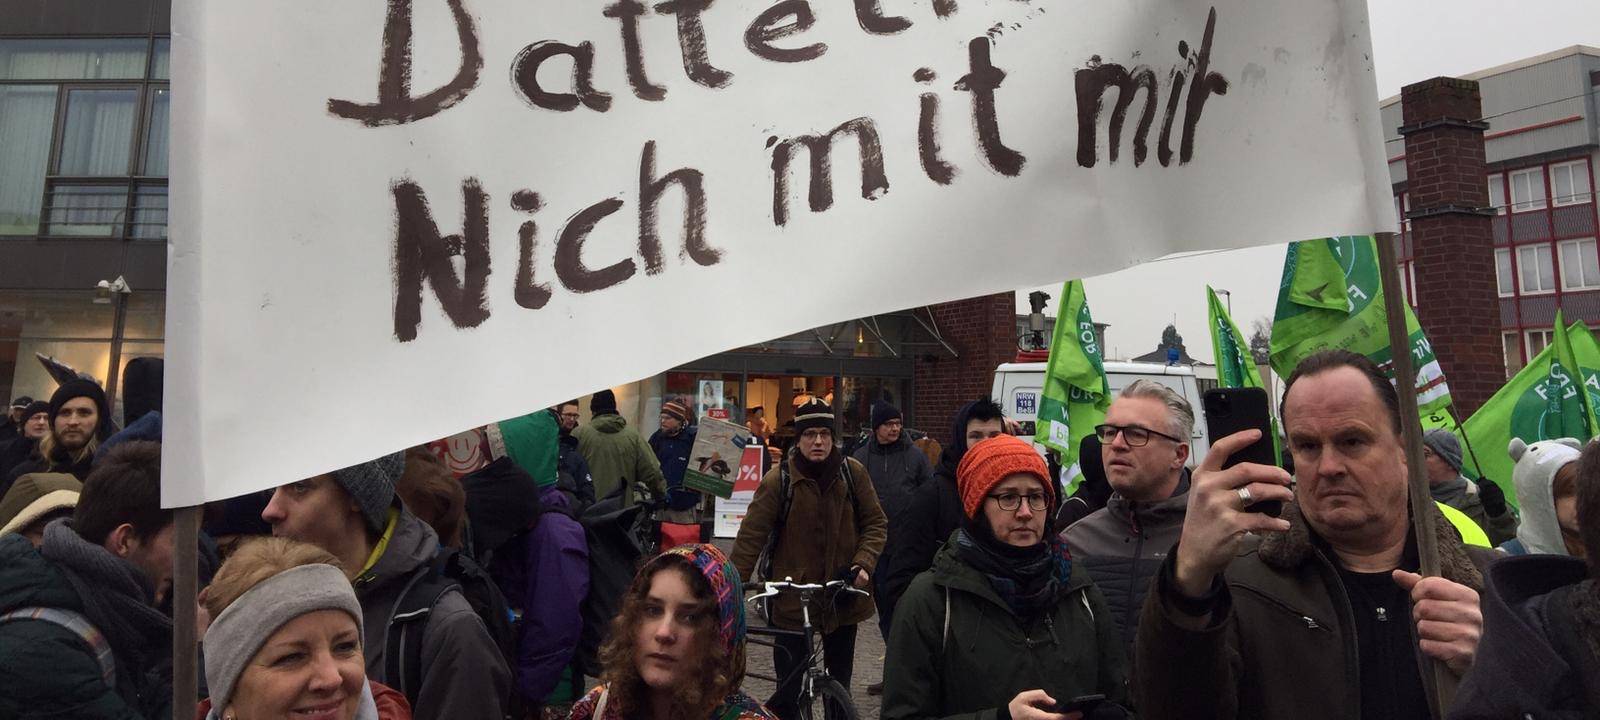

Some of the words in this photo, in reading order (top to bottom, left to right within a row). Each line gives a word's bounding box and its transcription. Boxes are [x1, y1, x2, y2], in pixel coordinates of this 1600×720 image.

[328, 0, 1031, 127] Datte
[390, 139, 725, 343] Nich
[766, 36, 1028, 226] mit
[1073, 6, 1229, 169] mir
[1016, 392, 1035, 400] NRW
